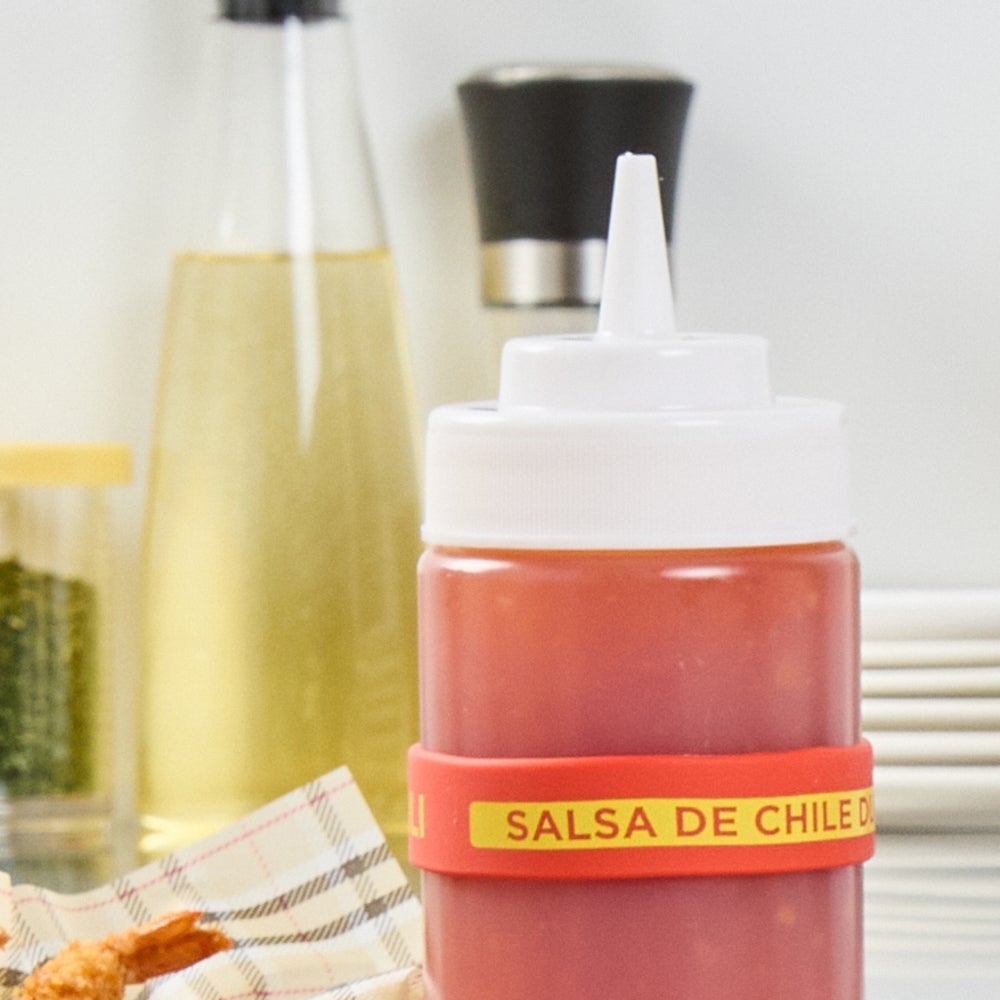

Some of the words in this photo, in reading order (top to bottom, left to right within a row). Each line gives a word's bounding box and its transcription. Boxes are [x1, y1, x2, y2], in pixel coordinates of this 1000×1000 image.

[506, 806, 656, 841] SALSA
[676, 805, 738, 837] DE
[755, 799, 851, 834] CHILE
